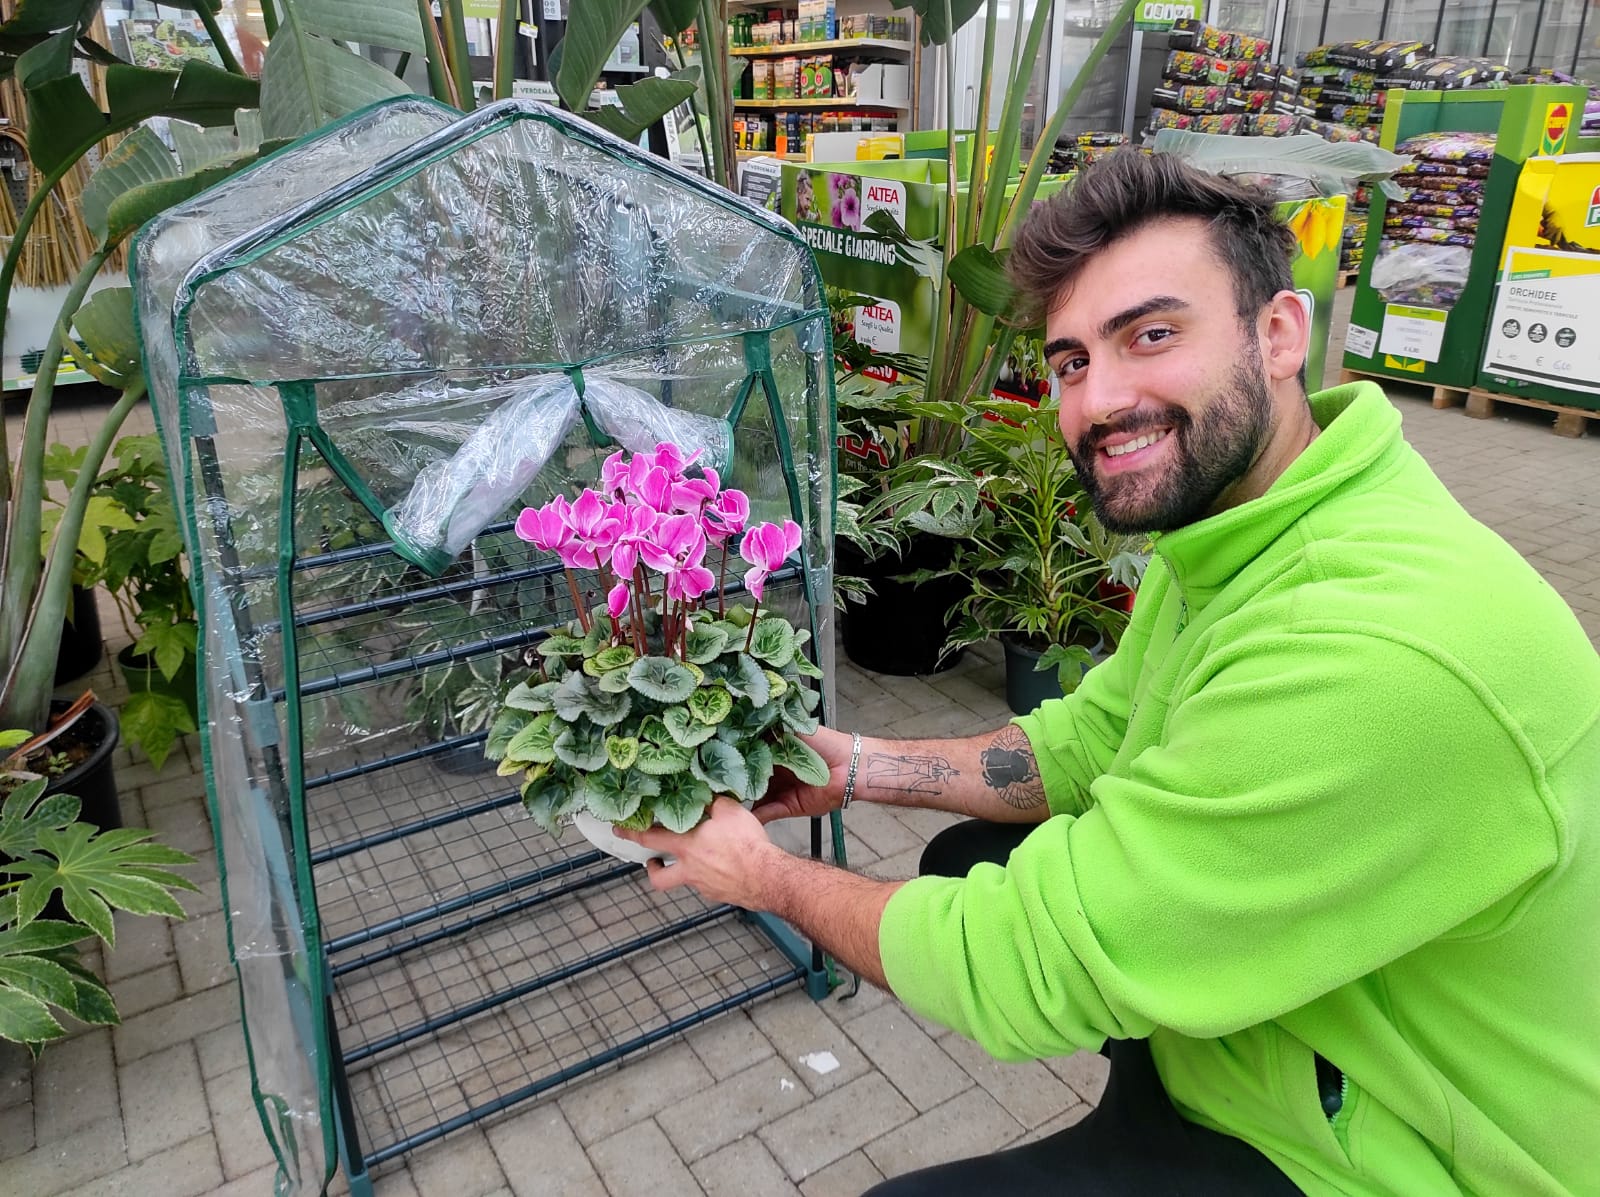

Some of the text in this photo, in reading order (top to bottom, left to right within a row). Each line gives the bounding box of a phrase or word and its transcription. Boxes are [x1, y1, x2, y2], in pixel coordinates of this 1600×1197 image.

[867, 186, 899, 204] ALTEA
[801, 226, 897, 266] SPECIALE GIARDINO
[1509, 287, 1558, 301] ORCHIDEE
[862, 305, 894, 323] ALTEA
[1535, 356, 1545, 367] €
